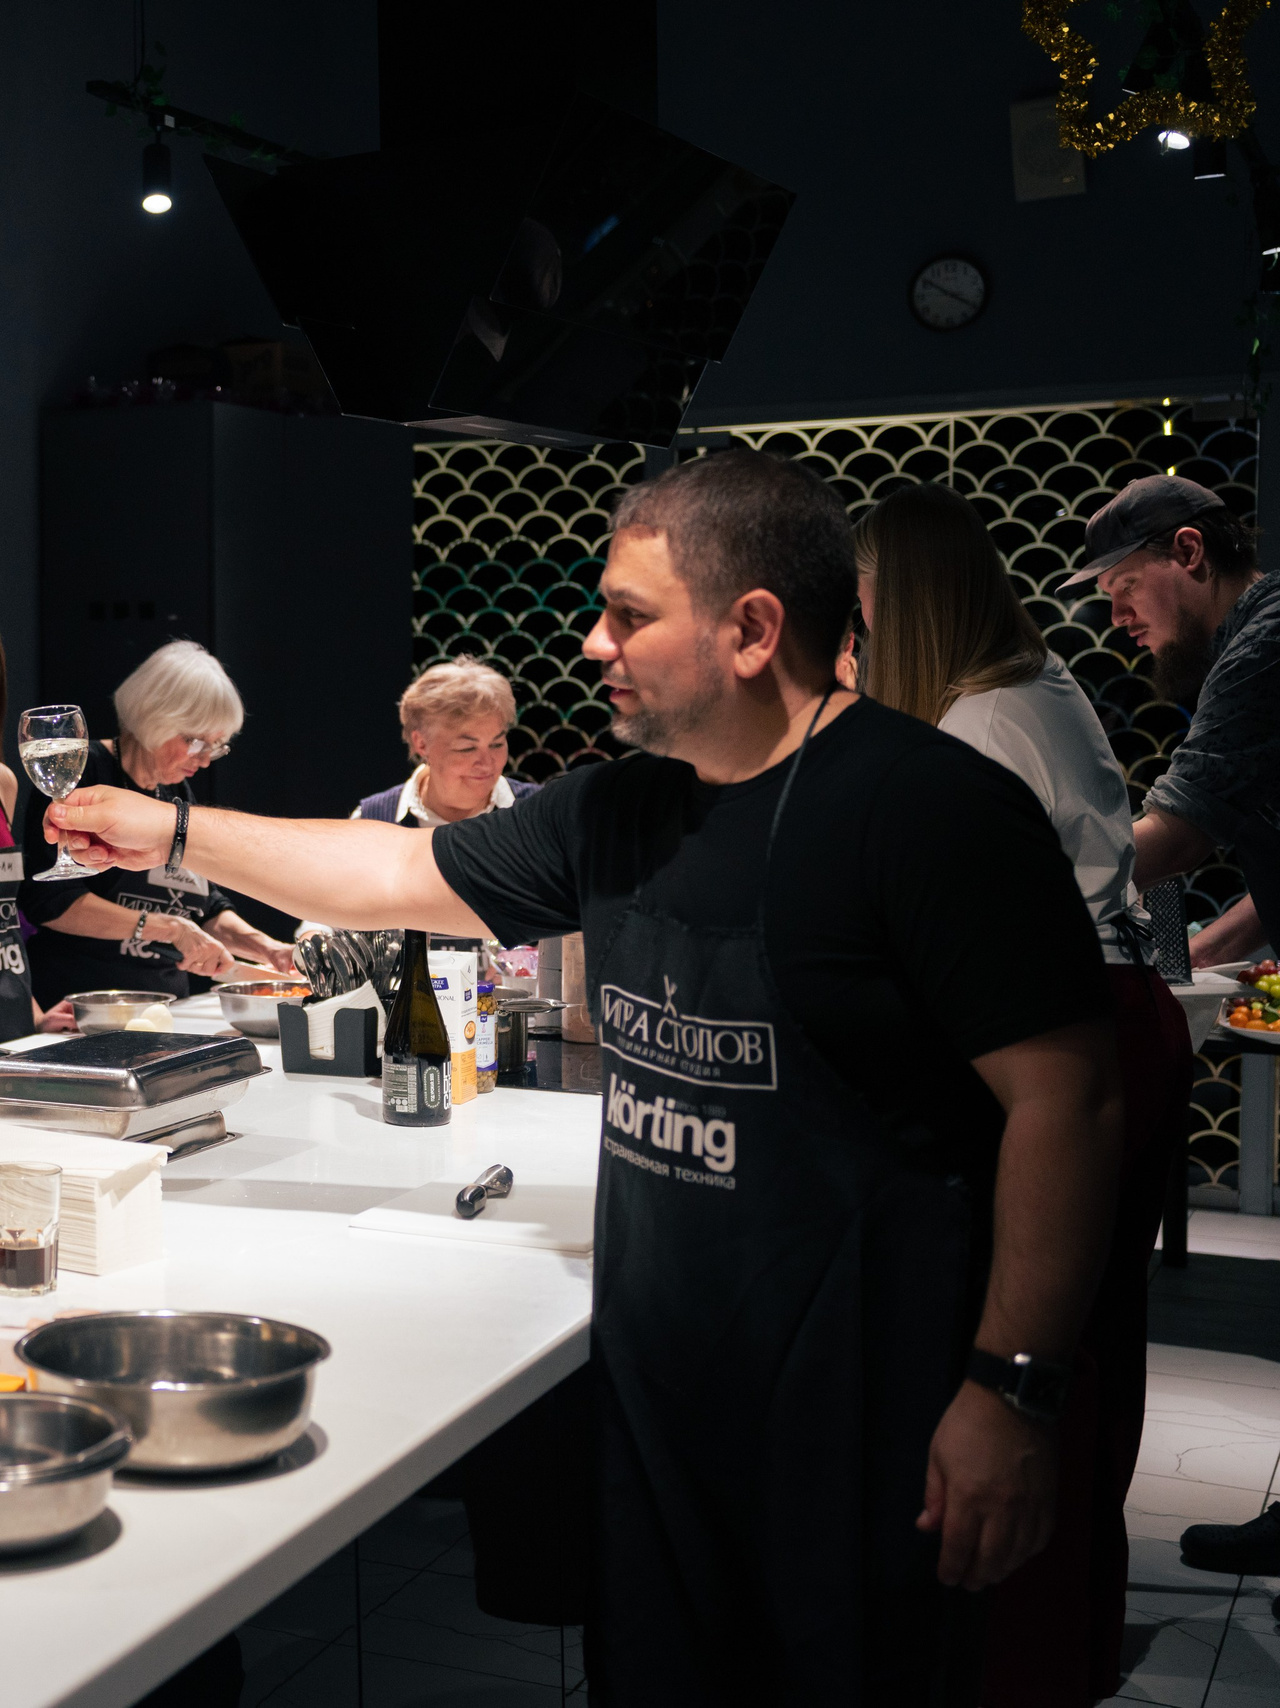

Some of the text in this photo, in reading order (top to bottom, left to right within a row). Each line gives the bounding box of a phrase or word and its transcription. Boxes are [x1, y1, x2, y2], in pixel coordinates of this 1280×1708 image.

[655, 1016, 764, 1065] СТОЛОВ
[606, 1072, 737, 1174] körting
[672, 1165, 737, 1190] техника
